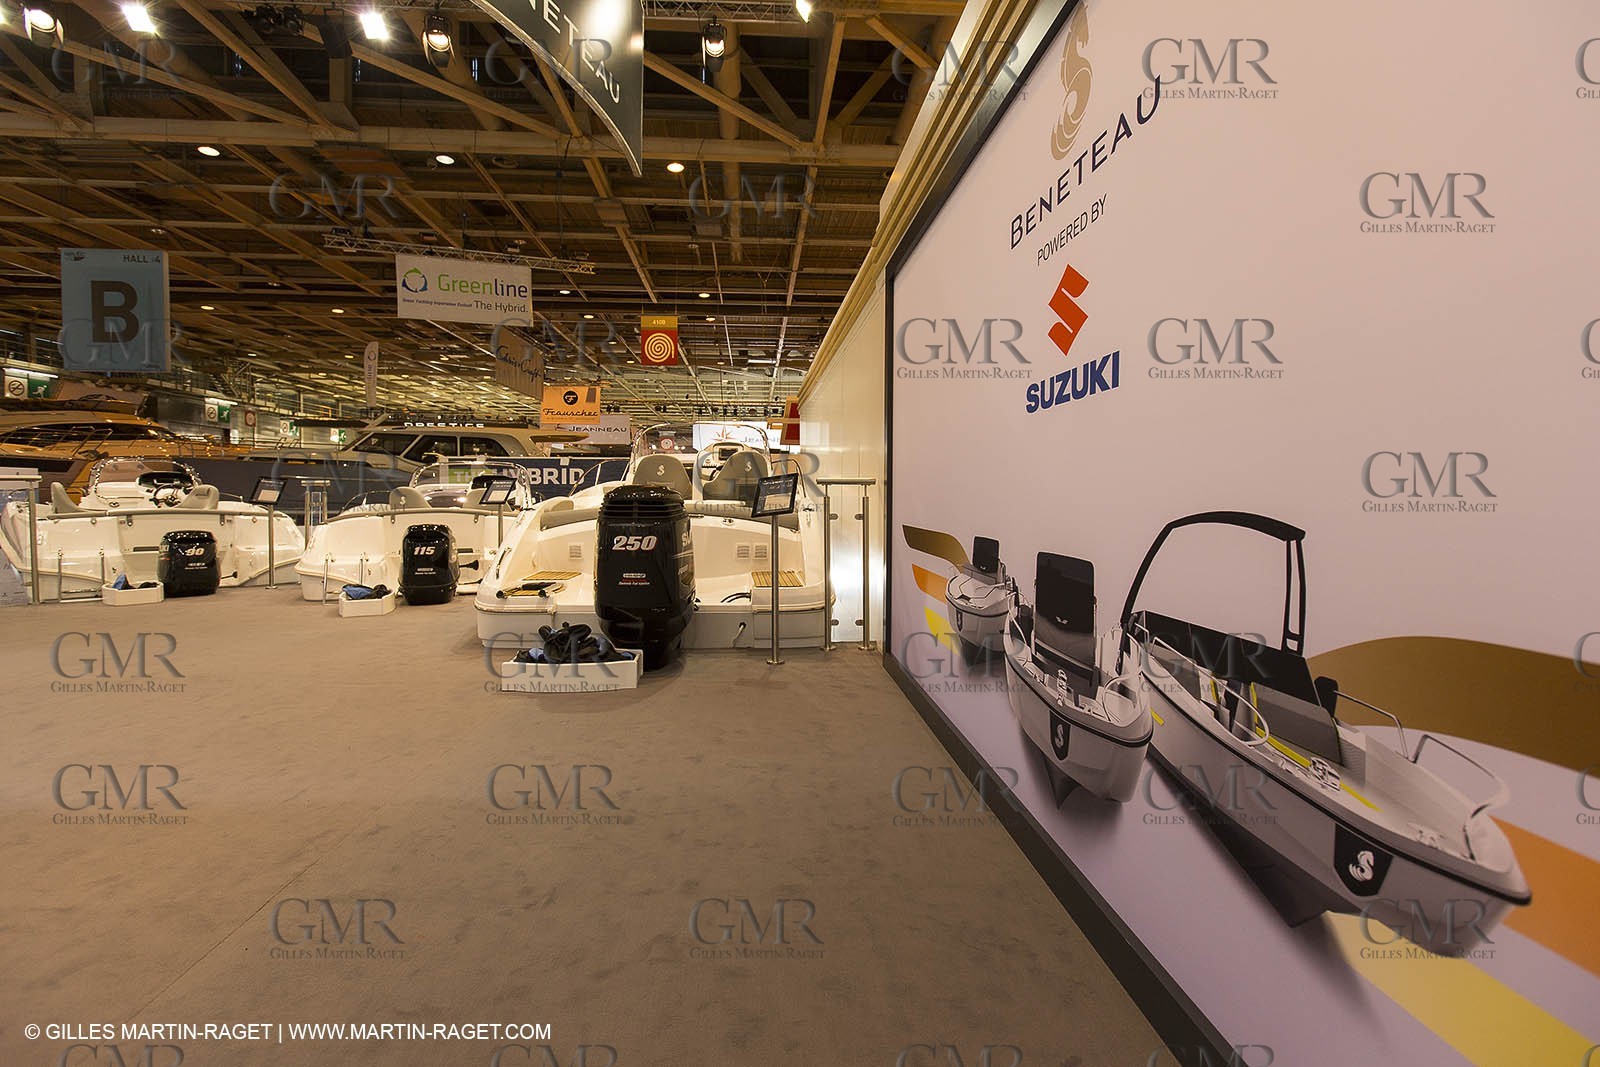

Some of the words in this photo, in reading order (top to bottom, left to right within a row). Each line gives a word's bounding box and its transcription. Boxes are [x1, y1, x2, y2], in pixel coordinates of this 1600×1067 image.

[1010, 75, 1161, 249] BENETEAU
[1037, 211, 1088, 266] POWERED
[1091, 193, 1107, 223] BY
[123, 255, 148, 263] HALL
[437, 274, 528, 298] Greenline
[91, 281, 139, 343] B
[474, 301, 492, 310] The
[494, 302, 529, 313] Hybrid.
[1026, 351, 1120, 413] SUZUKI
[185, 547, 205, 556] 90
[414, 546, 436, 555] 115
[612, 535, 657, 551] 250
